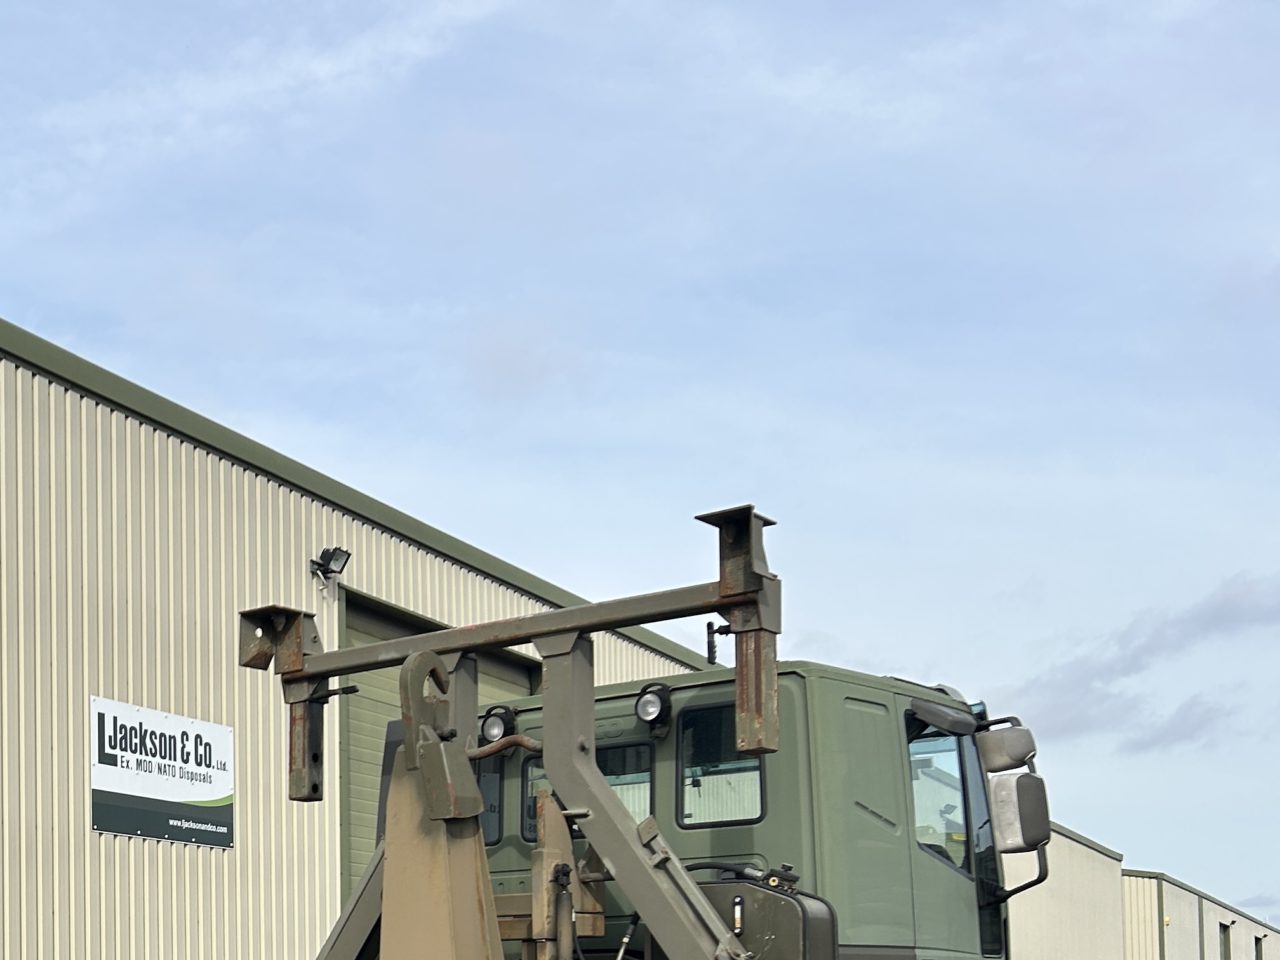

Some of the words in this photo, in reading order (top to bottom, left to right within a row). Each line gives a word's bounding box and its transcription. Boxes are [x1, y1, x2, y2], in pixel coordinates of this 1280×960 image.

[180, 731, 191, 764] &
[194, 734, 215, 769] Co.
[120, 756, 133, 770] Ex.
[136, 758, 176, 778] MOD/NATO
[179, 766, 213, 785] Disposals
